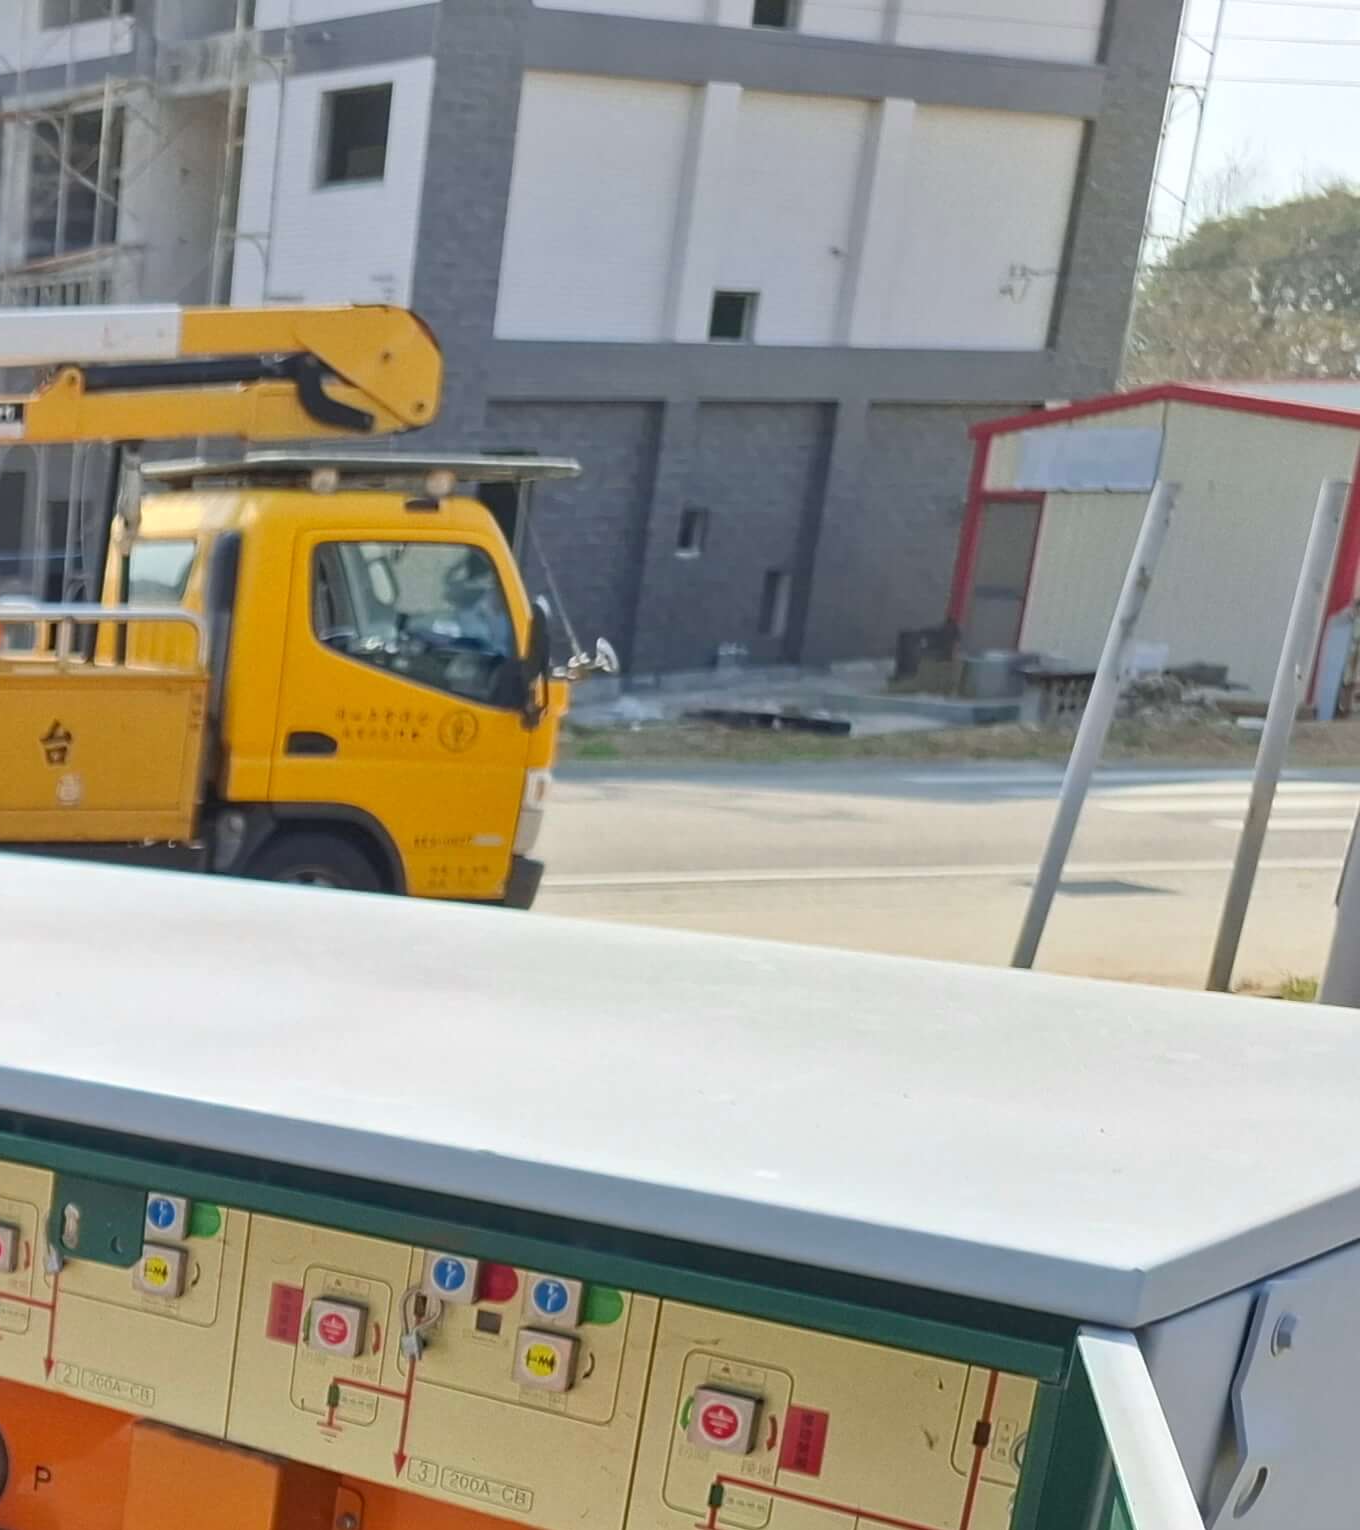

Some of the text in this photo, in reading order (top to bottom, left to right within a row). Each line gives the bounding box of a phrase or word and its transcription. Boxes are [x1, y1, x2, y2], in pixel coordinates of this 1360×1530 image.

[34, 1464, 51, 1491] P
[417, 1460, 429, 1482] 3
[448, 1471, 491, 1496] 200A
